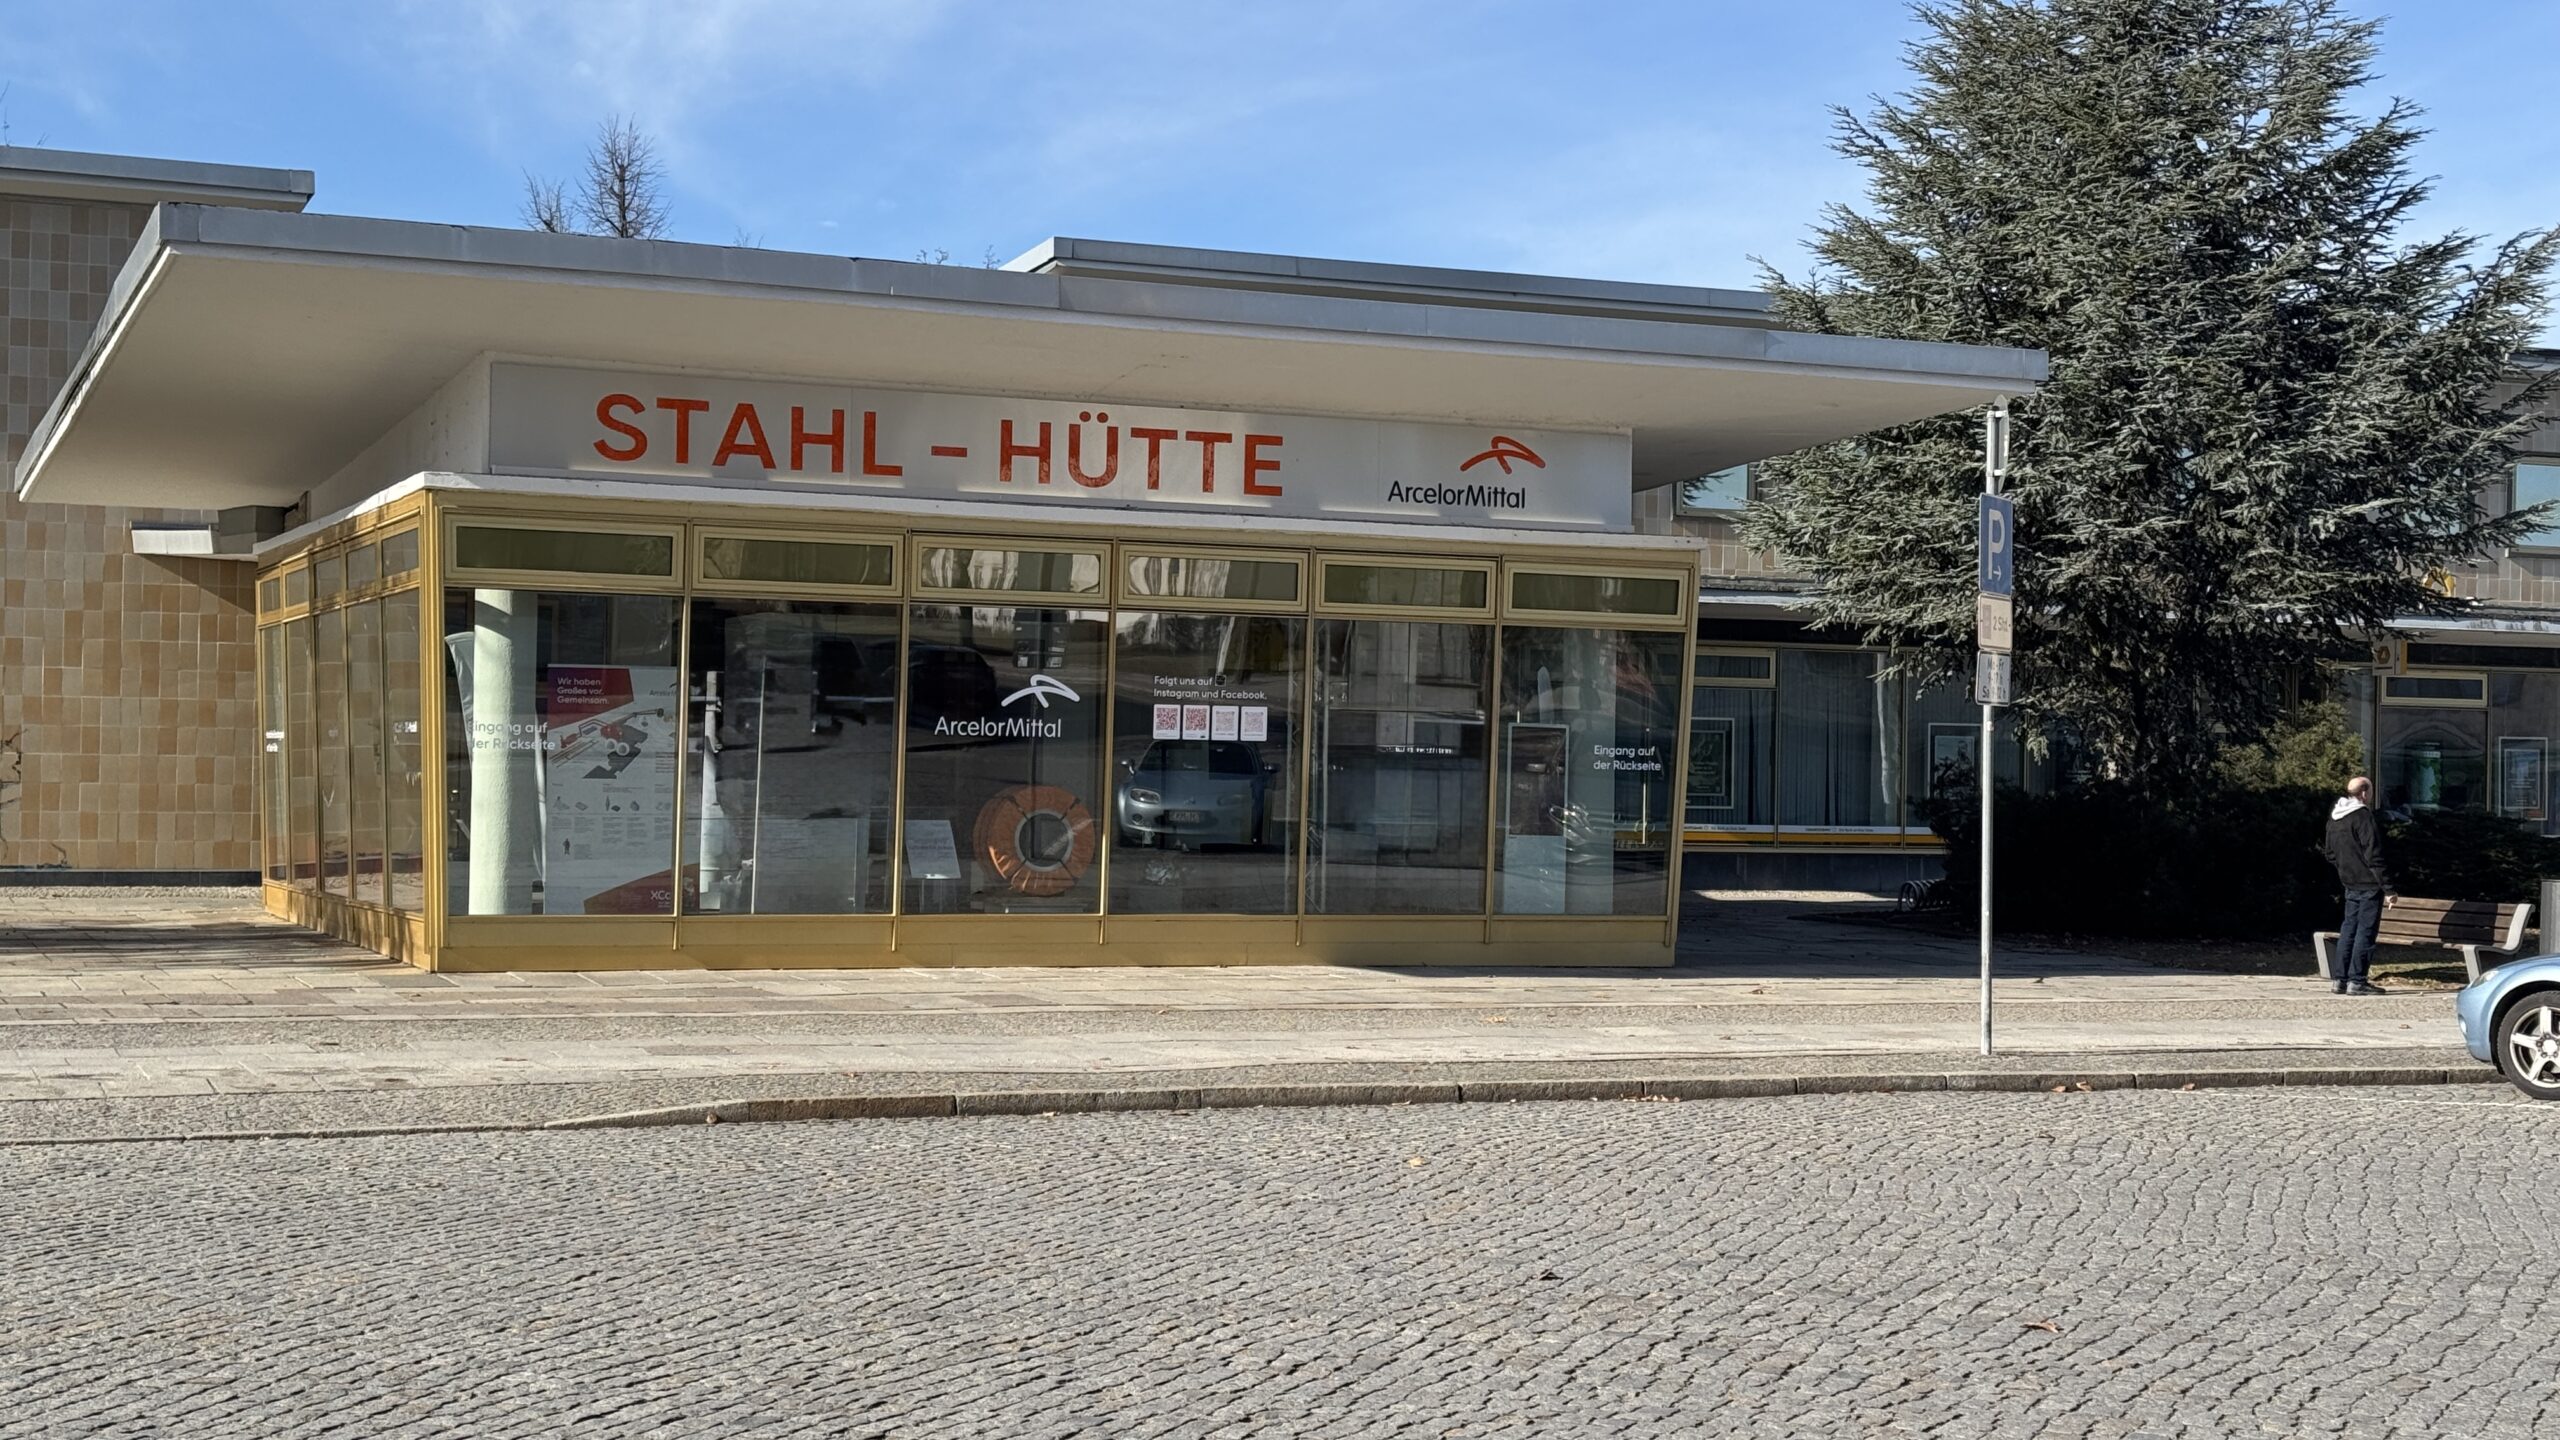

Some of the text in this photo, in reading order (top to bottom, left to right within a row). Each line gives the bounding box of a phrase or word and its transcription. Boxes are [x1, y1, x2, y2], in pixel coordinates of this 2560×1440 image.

[591, 393, 903, 477] STAHL
[1001, 410, 1284, 498] HÜTTE
[1387, 480, 1526, 509] ArcelorMittal
[1987, 508, 2006, 580] P
[573, 678, 601, 686] haben
[1154, 675, 1214, 687] Folgt uns auf
[1153, 688, 1268, 700] Instagram und Facebook.
[557, 696, 609, 705] Gemeinsam.
[525, 722, 549, 734] auf
[934, 716, 1062, 738] ArcelorMittal
[1594, 745, 1656, 758] Eingang auf
[1593, 760, 1662, 771] der Rückseite
